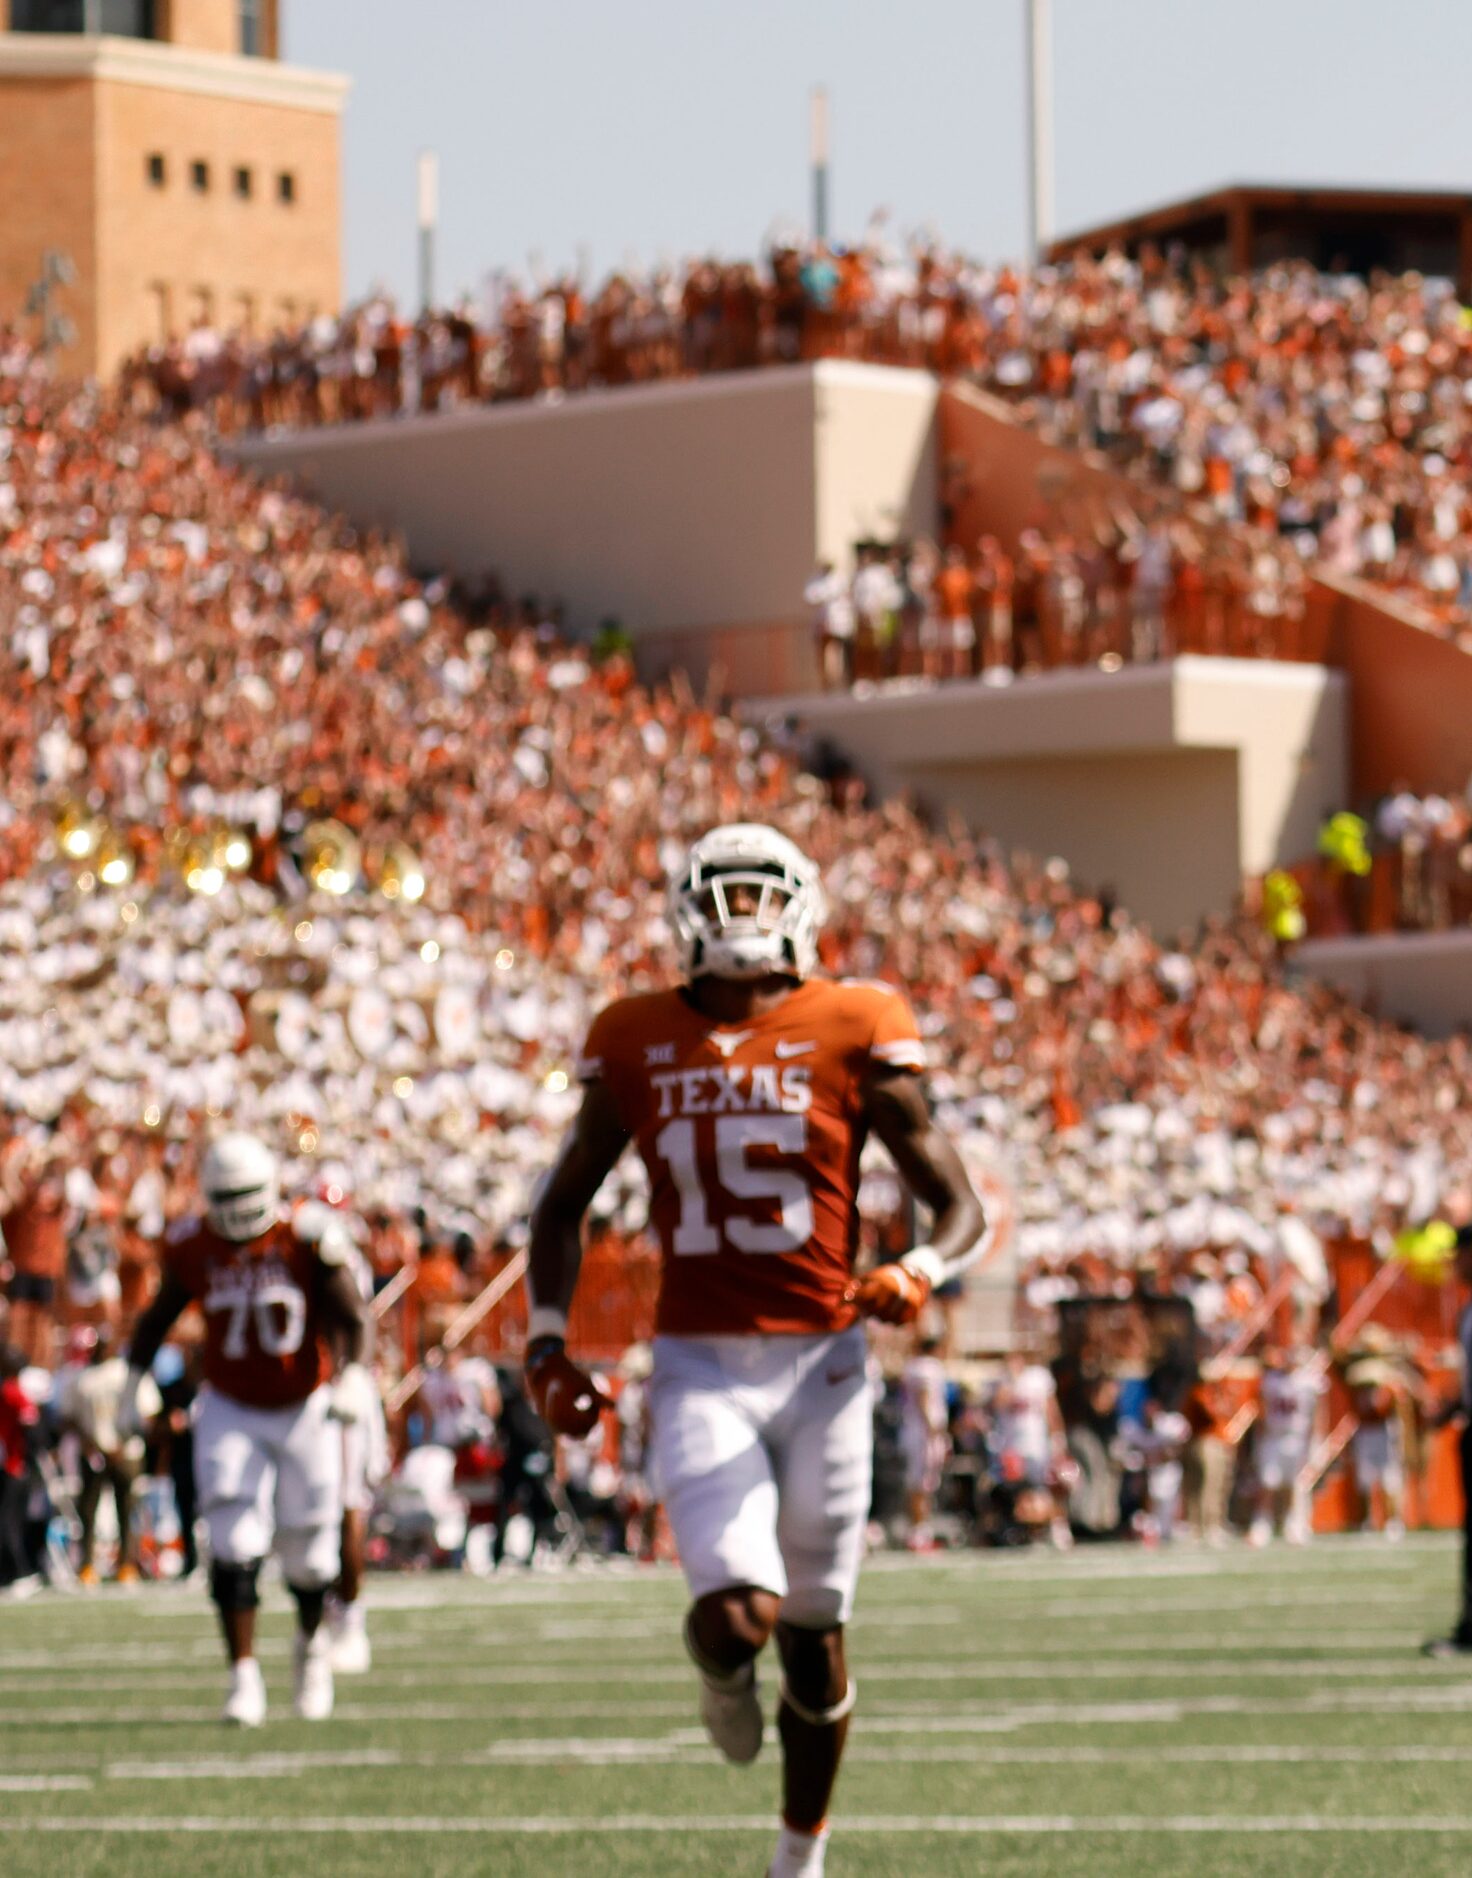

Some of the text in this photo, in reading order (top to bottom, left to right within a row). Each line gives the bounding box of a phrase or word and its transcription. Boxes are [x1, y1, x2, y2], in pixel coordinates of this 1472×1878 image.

[650, 1064, 813, 1118] TEXAS
[655, 1114, 816, 1257] 15
[203, 1284, 307, 1359] 70
